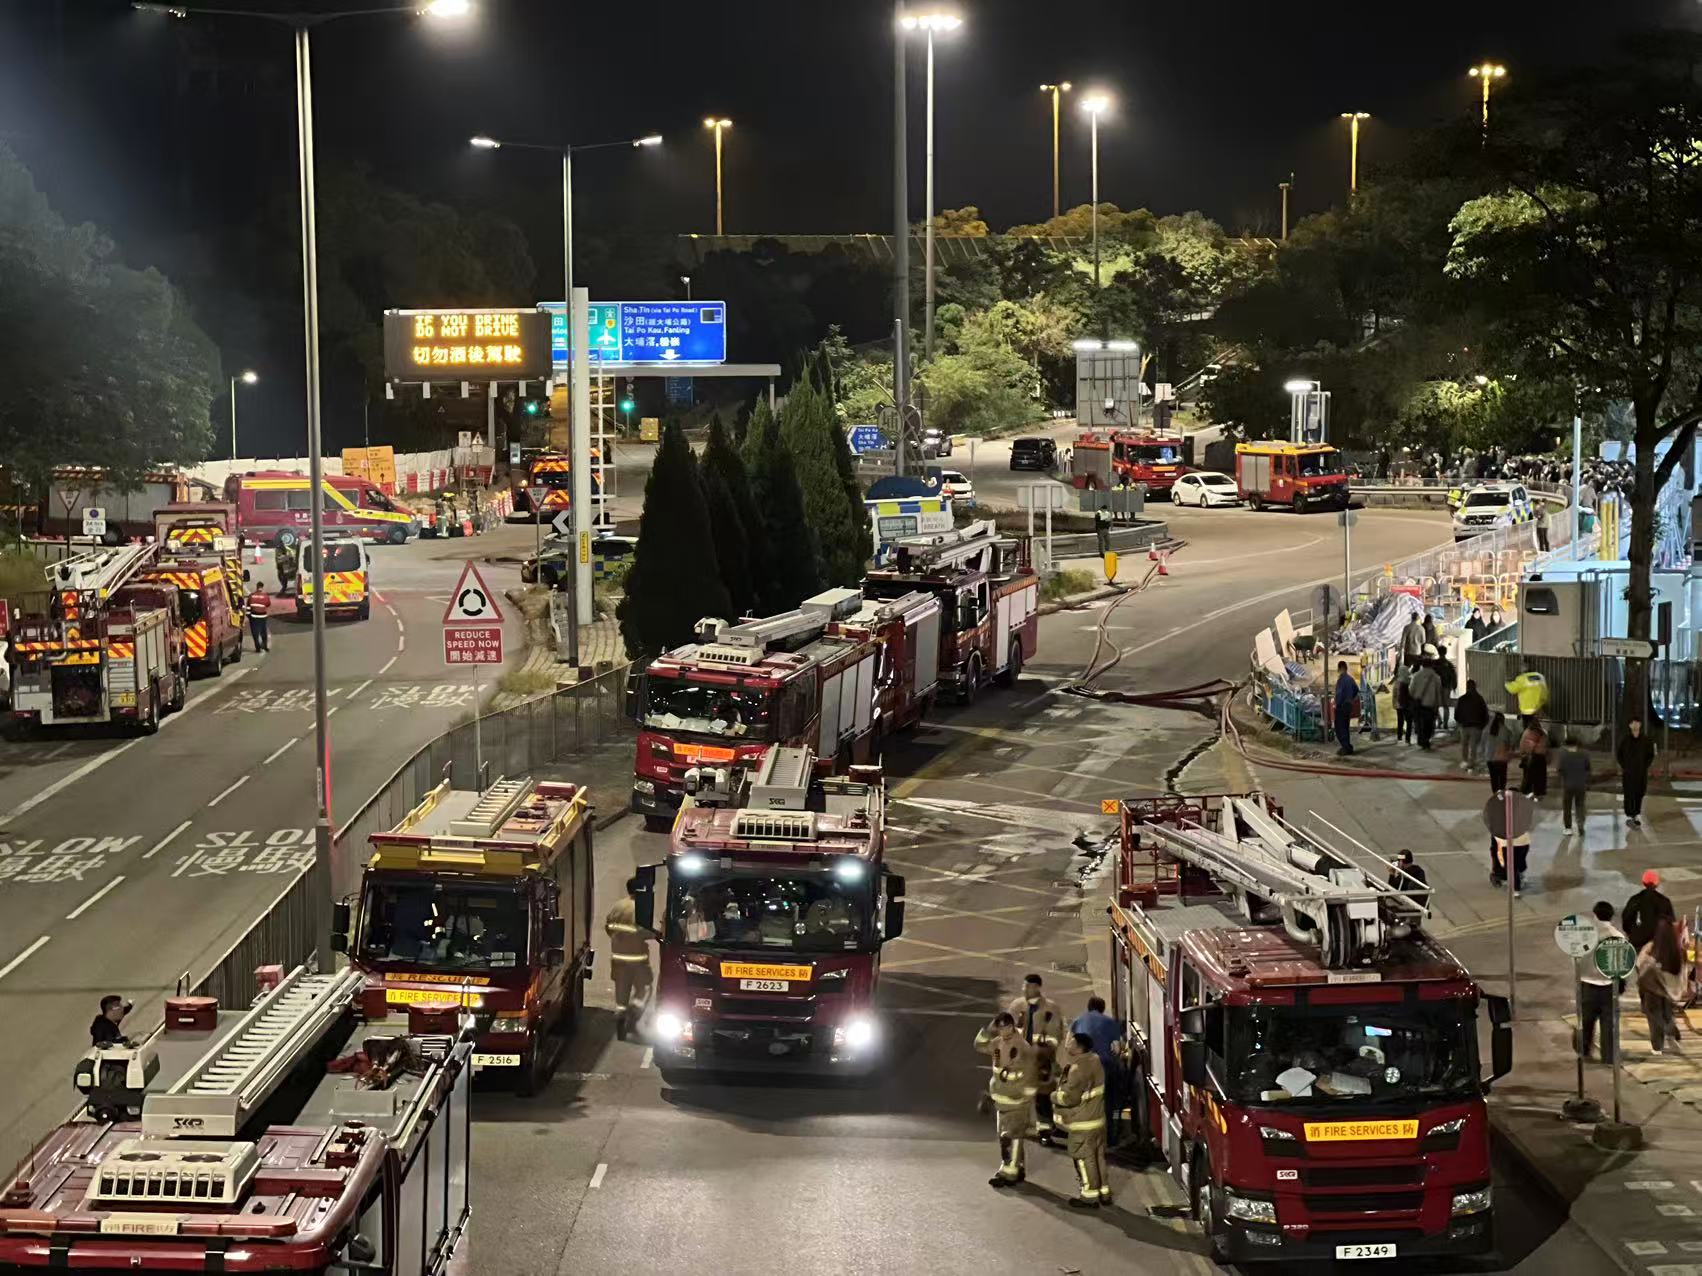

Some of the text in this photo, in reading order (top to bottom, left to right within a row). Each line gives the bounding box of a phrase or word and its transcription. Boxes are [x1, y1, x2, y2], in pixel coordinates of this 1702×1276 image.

[415, 315, 519, 326] IF YOU DRINK
[415, 325, 519, 337] DO NOT DRIVE
[455, 631, 491, 639] REDUCE
[446, 640, 500, 648] SPEED NOW
[196, 828, 316, 849] SLO
[735, 966, 796, 978] FIRE SERVICES
[746, 980, 783, 990] F 2623
[399, 991, 419, 1002] FIRE
[421, 993, 459, 1003] SERVICE
[477, 1056, 513, 1065] F 2516
[1324, 1124, 1399, 1137] FIRE SERVICES
[122, 1223, 155, 1233] FIRE
[1343, 1246, 1389, 1257] F 2349
